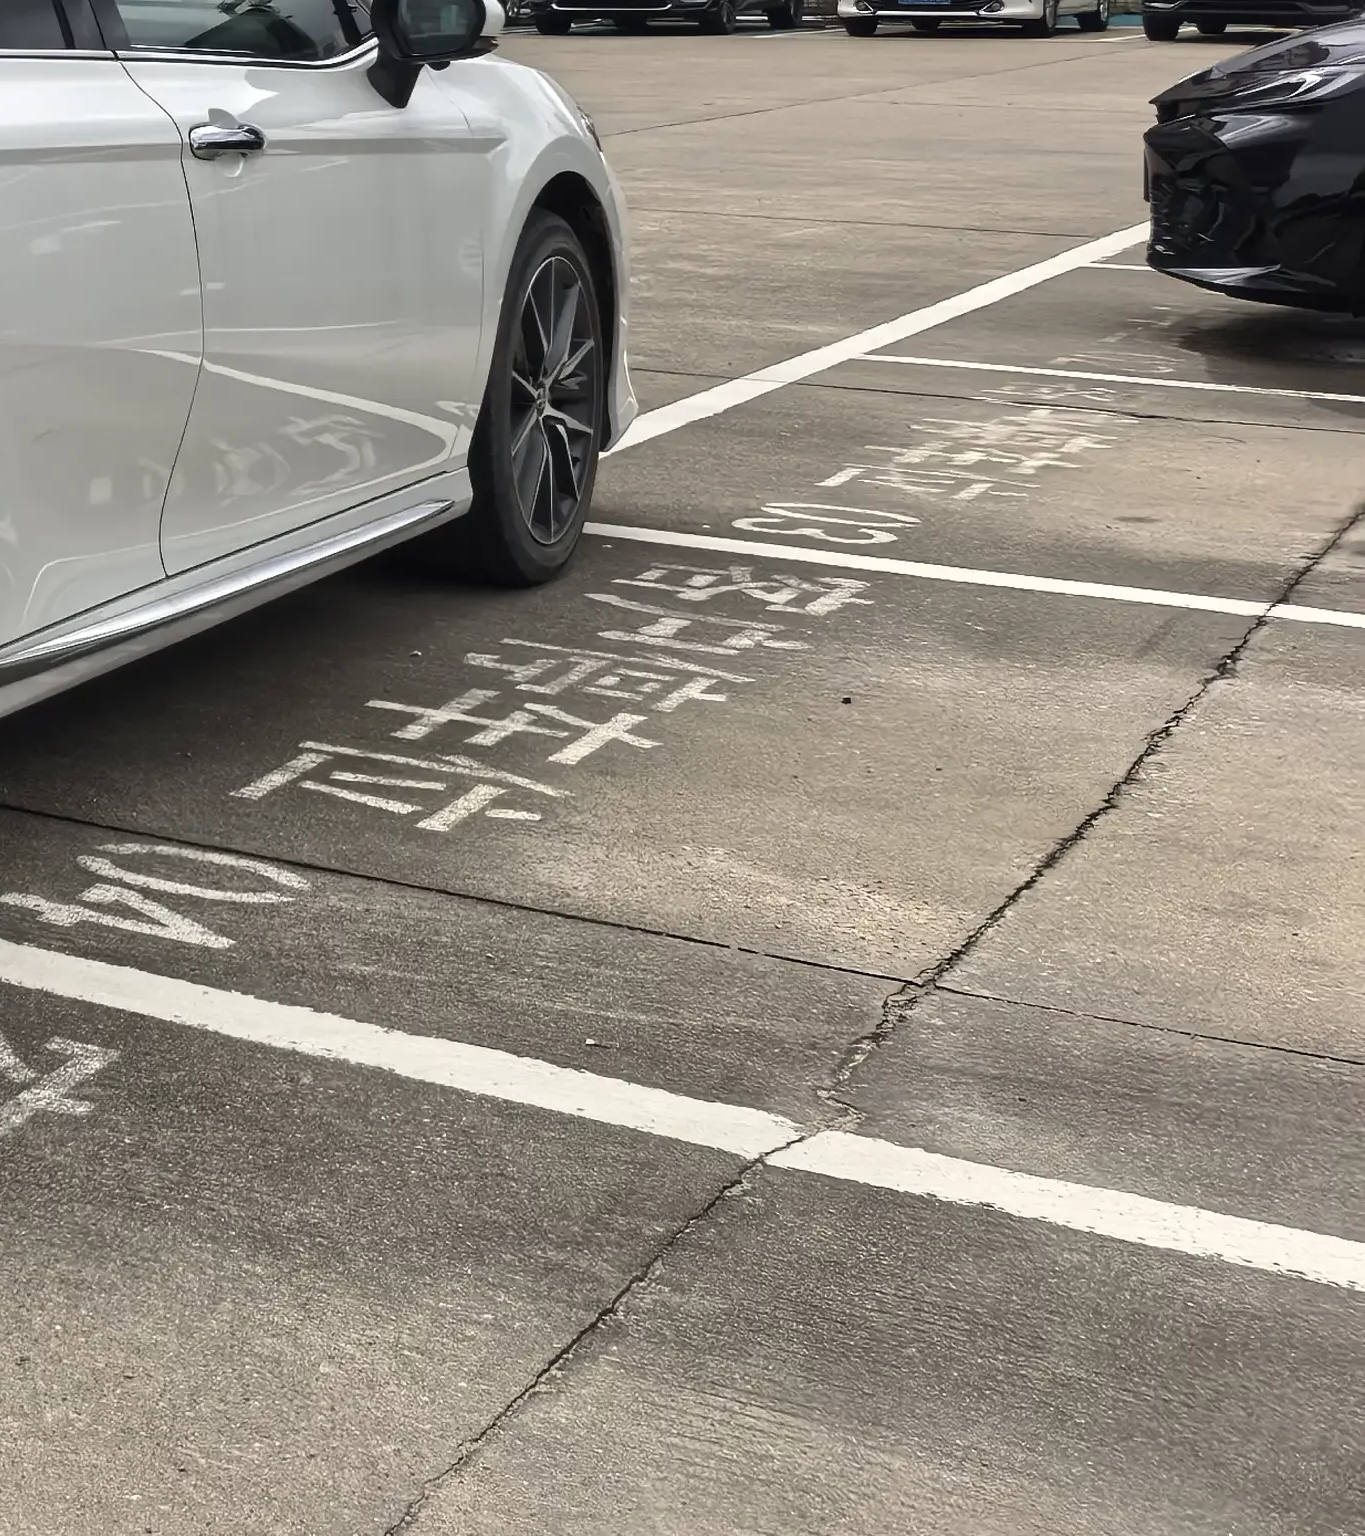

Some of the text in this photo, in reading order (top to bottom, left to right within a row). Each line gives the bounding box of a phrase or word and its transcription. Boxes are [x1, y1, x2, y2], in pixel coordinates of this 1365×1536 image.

[731, 501, 923, 545] 03
[0, 562, 875, 950] 客户停车位 04
